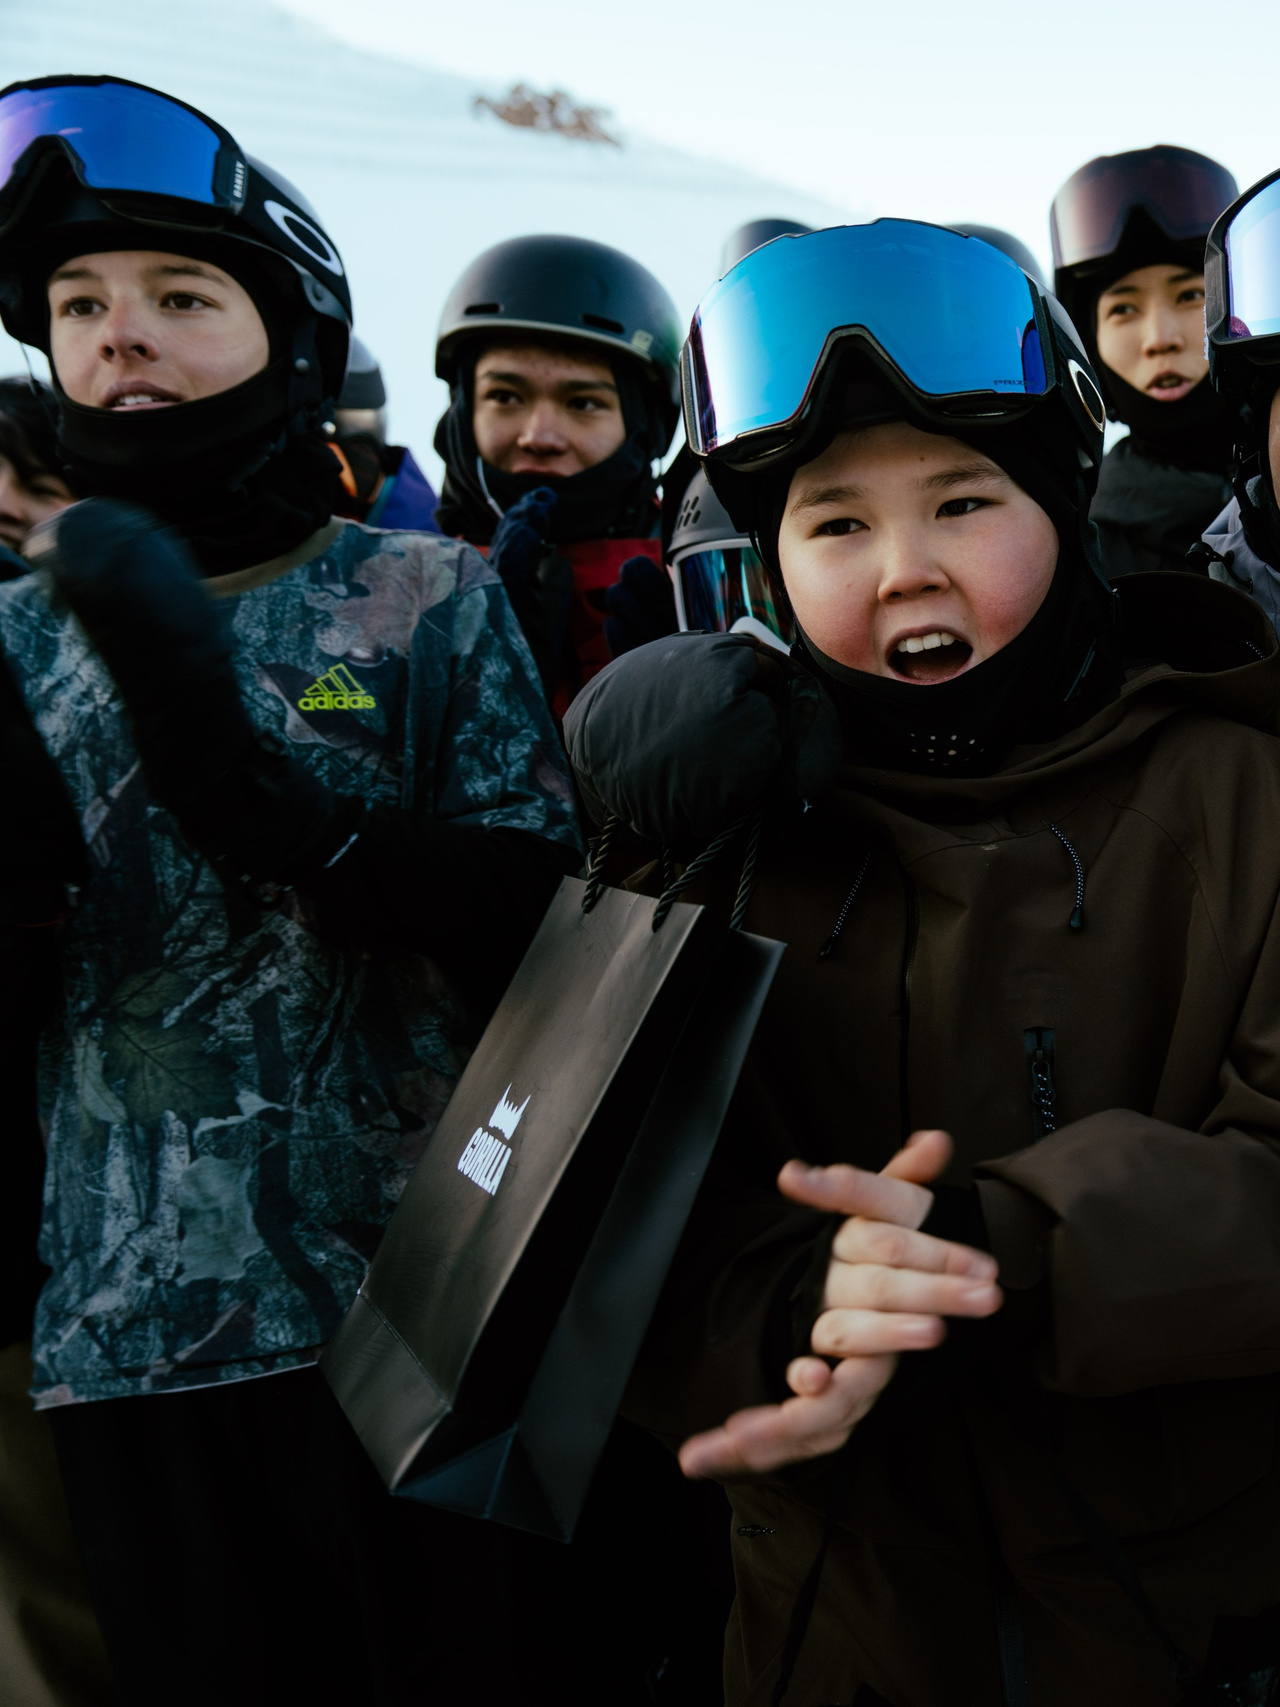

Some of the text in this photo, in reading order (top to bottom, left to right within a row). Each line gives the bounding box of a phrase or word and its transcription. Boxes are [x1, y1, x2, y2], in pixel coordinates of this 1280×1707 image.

[232, 160, 245, 199] OAKLEY
[298, 691, 377, 711] adidas
[457, 1126, 513, 1197] GORILLA
